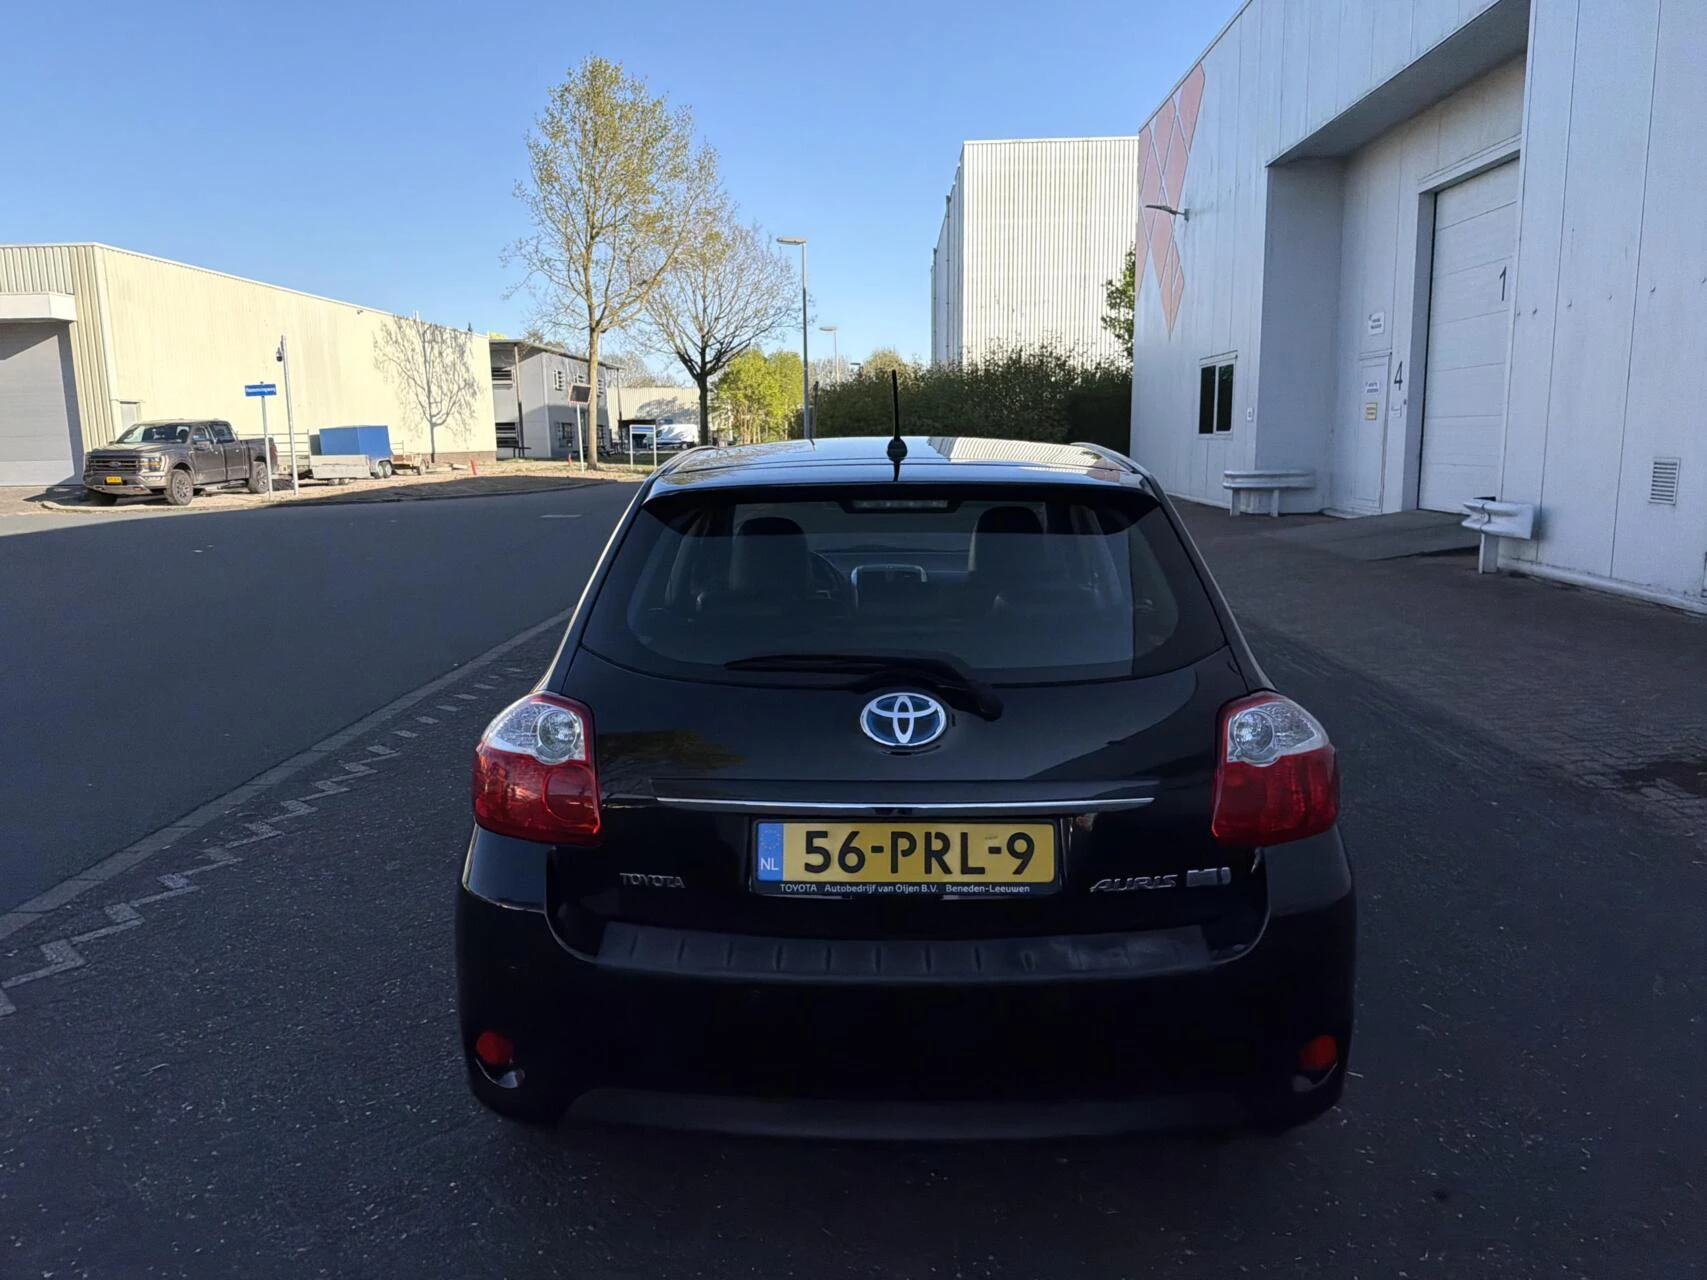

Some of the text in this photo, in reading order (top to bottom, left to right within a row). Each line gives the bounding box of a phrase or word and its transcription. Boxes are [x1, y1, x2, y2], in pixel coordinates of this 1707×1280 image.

[1499, 265, 1507, 302] 1
[1394, 360, 1403, 391] 4
[804, 831, 1036, 875] 56-PRL-9
[760, 859, 780, 871] NL
[619, 872, 687, 889] TOYOTA
[780, 883, 1031, 895] TOYOTA Autobedrijf van Oijen B.V. Beneden-Leeuwen
[1090, 874, 1179, 892] AURIS
